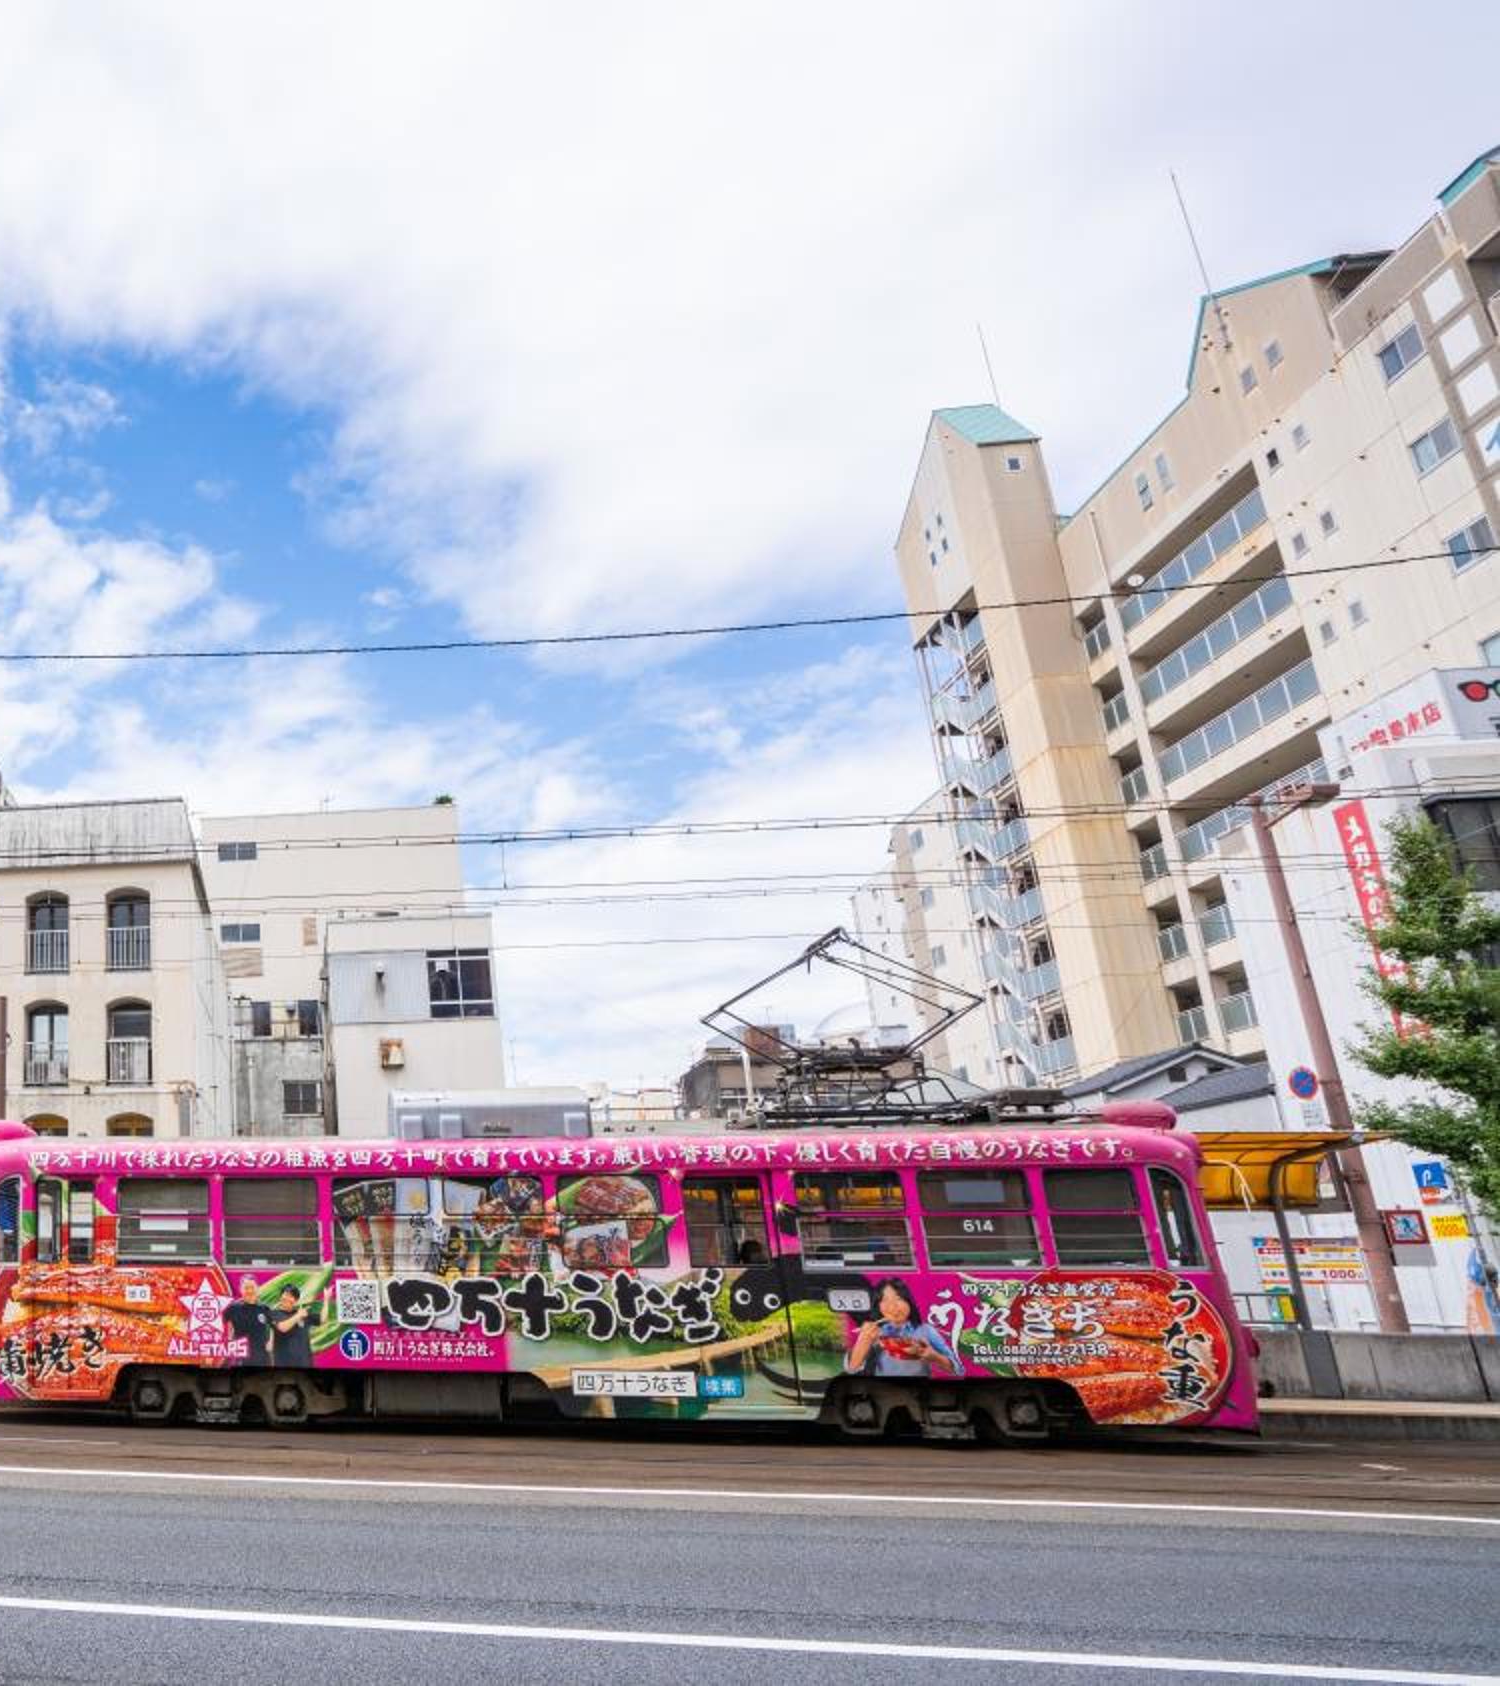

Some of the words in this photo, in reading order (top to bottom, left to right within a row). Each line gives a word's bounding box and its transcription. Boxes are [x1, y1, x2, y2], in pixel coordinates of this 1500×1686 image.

[963, 1219, 994, 1234] 614
[386, 1268, 722, 1343] 四万十うなぎ
[1157, 1280, 1208, 1410] うな重
[577, 1374, 688, 1394] 四万十うなぎ
